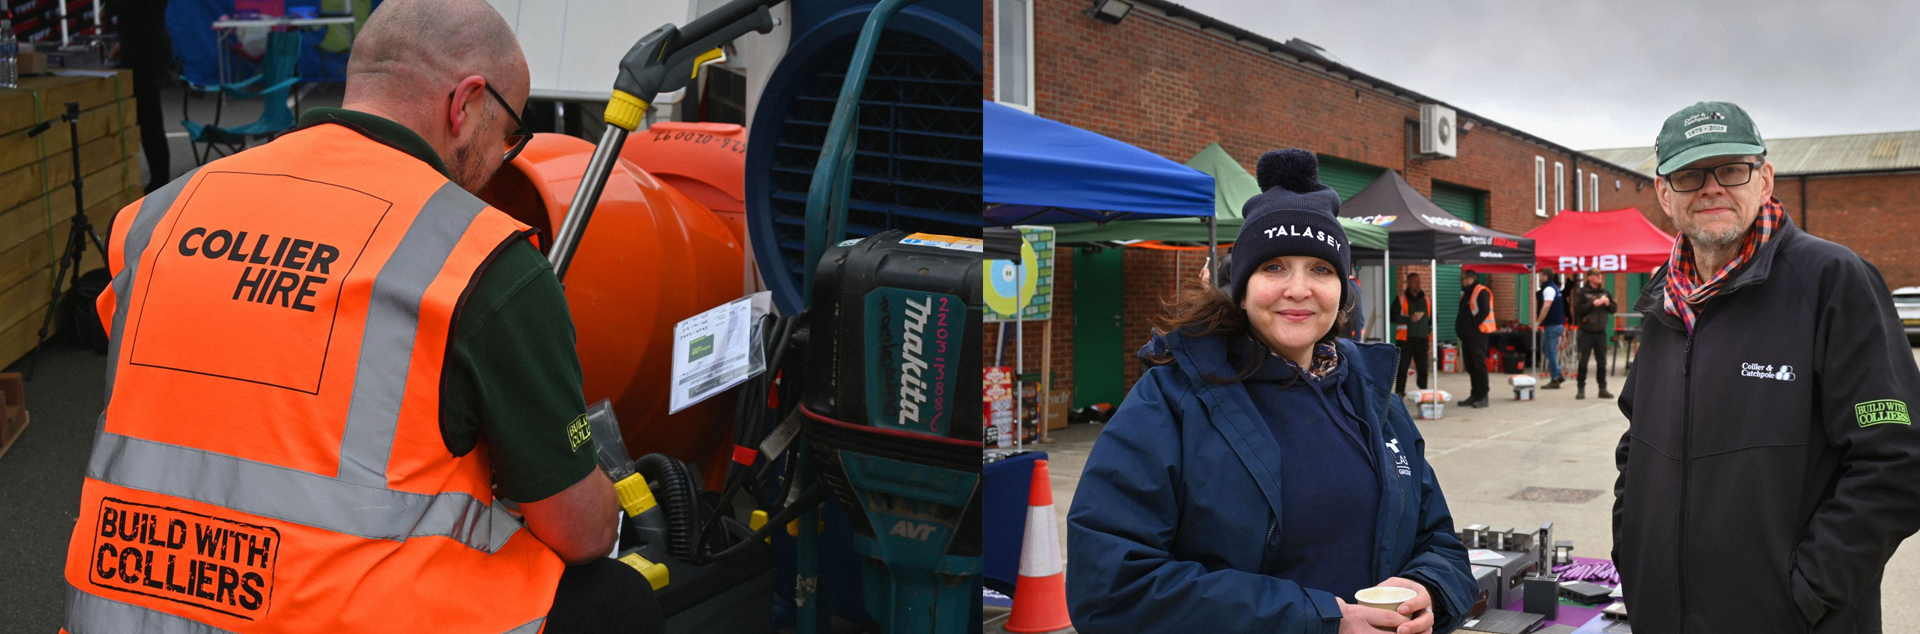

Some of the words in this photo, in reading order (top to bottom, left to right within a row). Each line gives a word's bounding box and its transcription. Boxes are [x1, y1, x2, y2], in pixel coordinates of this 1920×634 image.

[1687, 127, 1703, 136] 1975
[1264, 224, 1341, 252] TALASEY
[178, 226, 340, 275] COLLIER
[1559, 254, 1627, 272] RUBI
[232, 266, 328, 313] HIRE
[898, 295, 932, 425] Makita
[1741, 362, 1765, 371] Collier
[1741, 370, 1775, 379] Catchpole
[1857, 402, 1885, 415] BUILD
[1885, 402, 1906, 413] WITH
[1860, 411, 1909, 425] COLLIERS
[101, 506, 187, 550] BUILD
[195, 522, 271, 569] WITH
[889, 520, 937, 541] AVT
[96, 543, 265, 611] COLLIERS
